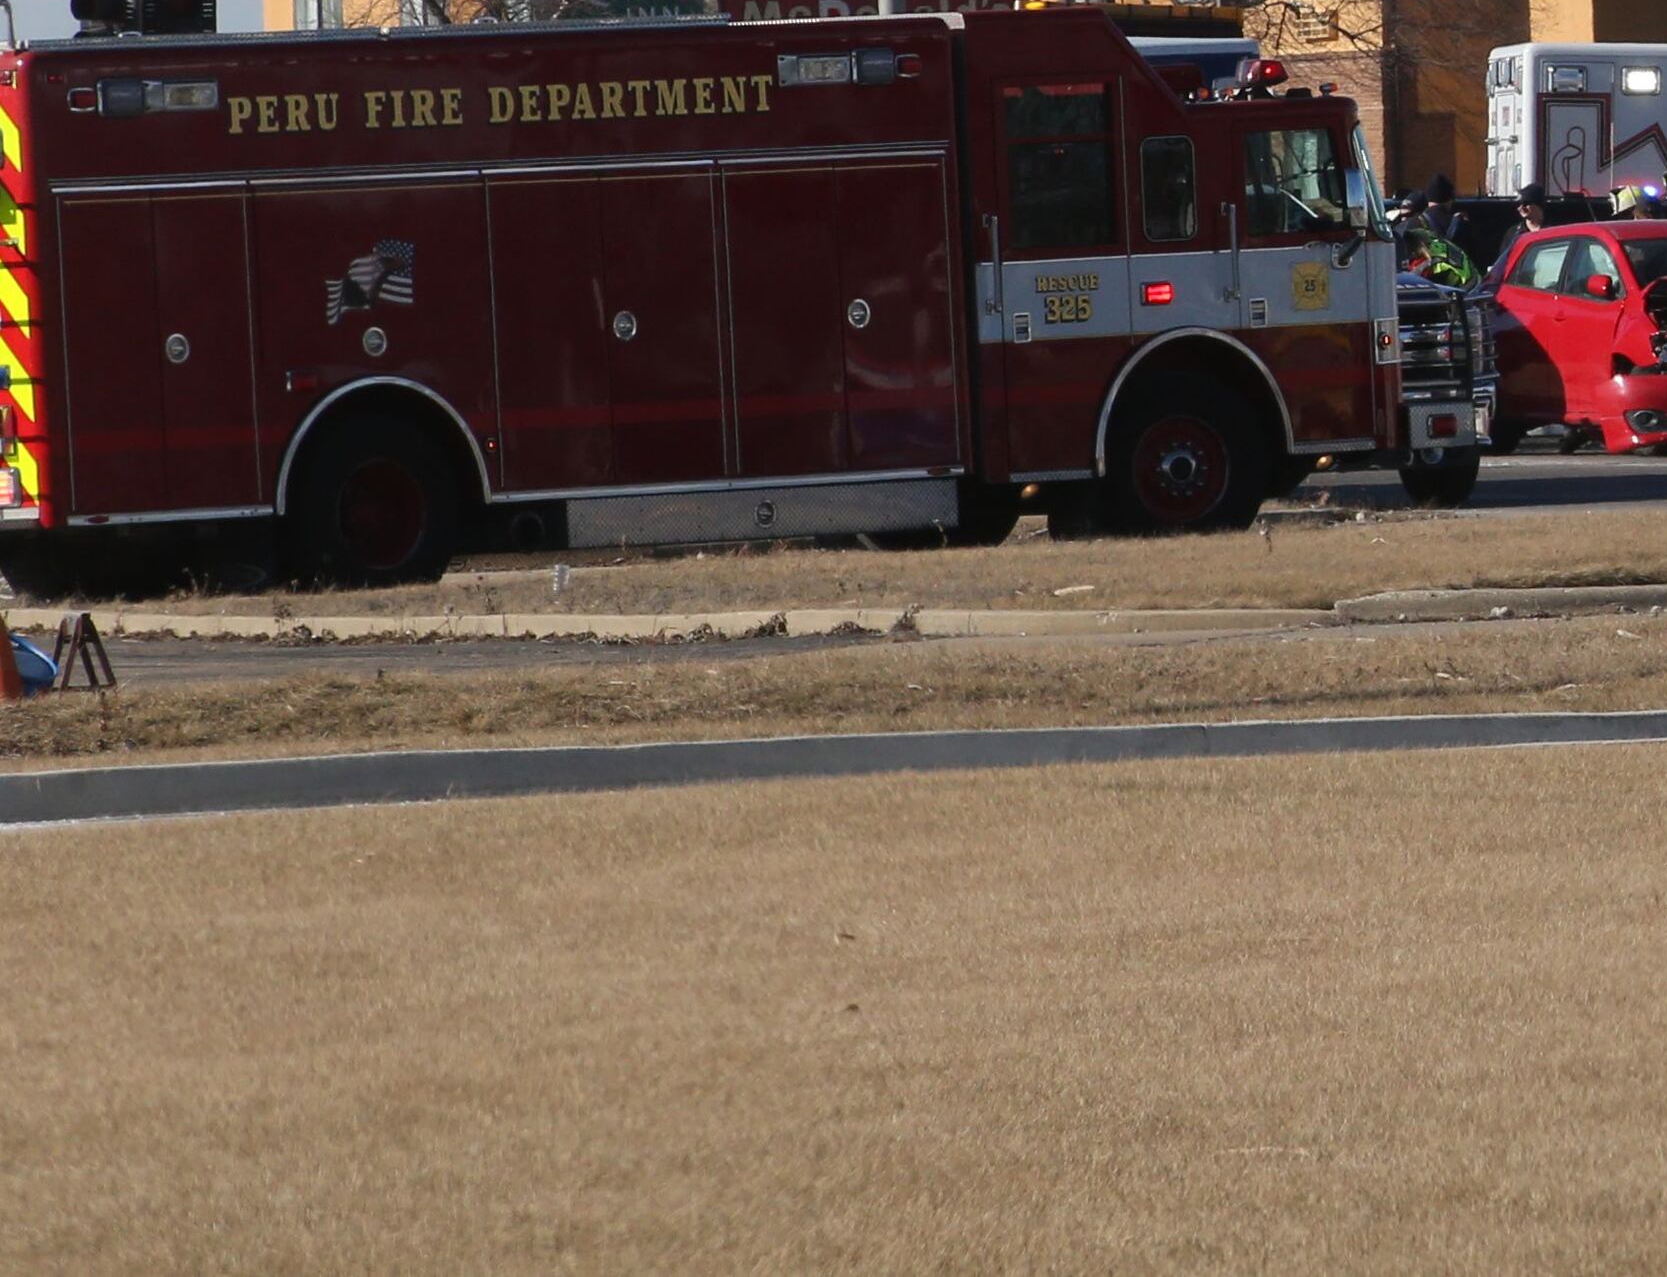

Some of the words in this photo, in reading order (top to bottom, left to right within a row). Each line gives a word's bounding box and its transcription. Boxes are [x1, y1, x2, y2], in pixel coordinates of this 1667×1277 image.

[227, 93, 339, 134] PERU
[364, 88, 463, 128] FIRE
[488, 75, 773, 123] DEPARTMENT
[1036, 274, 1099, 293] RESCUE
[1044, 295, 1094, 324] 325
